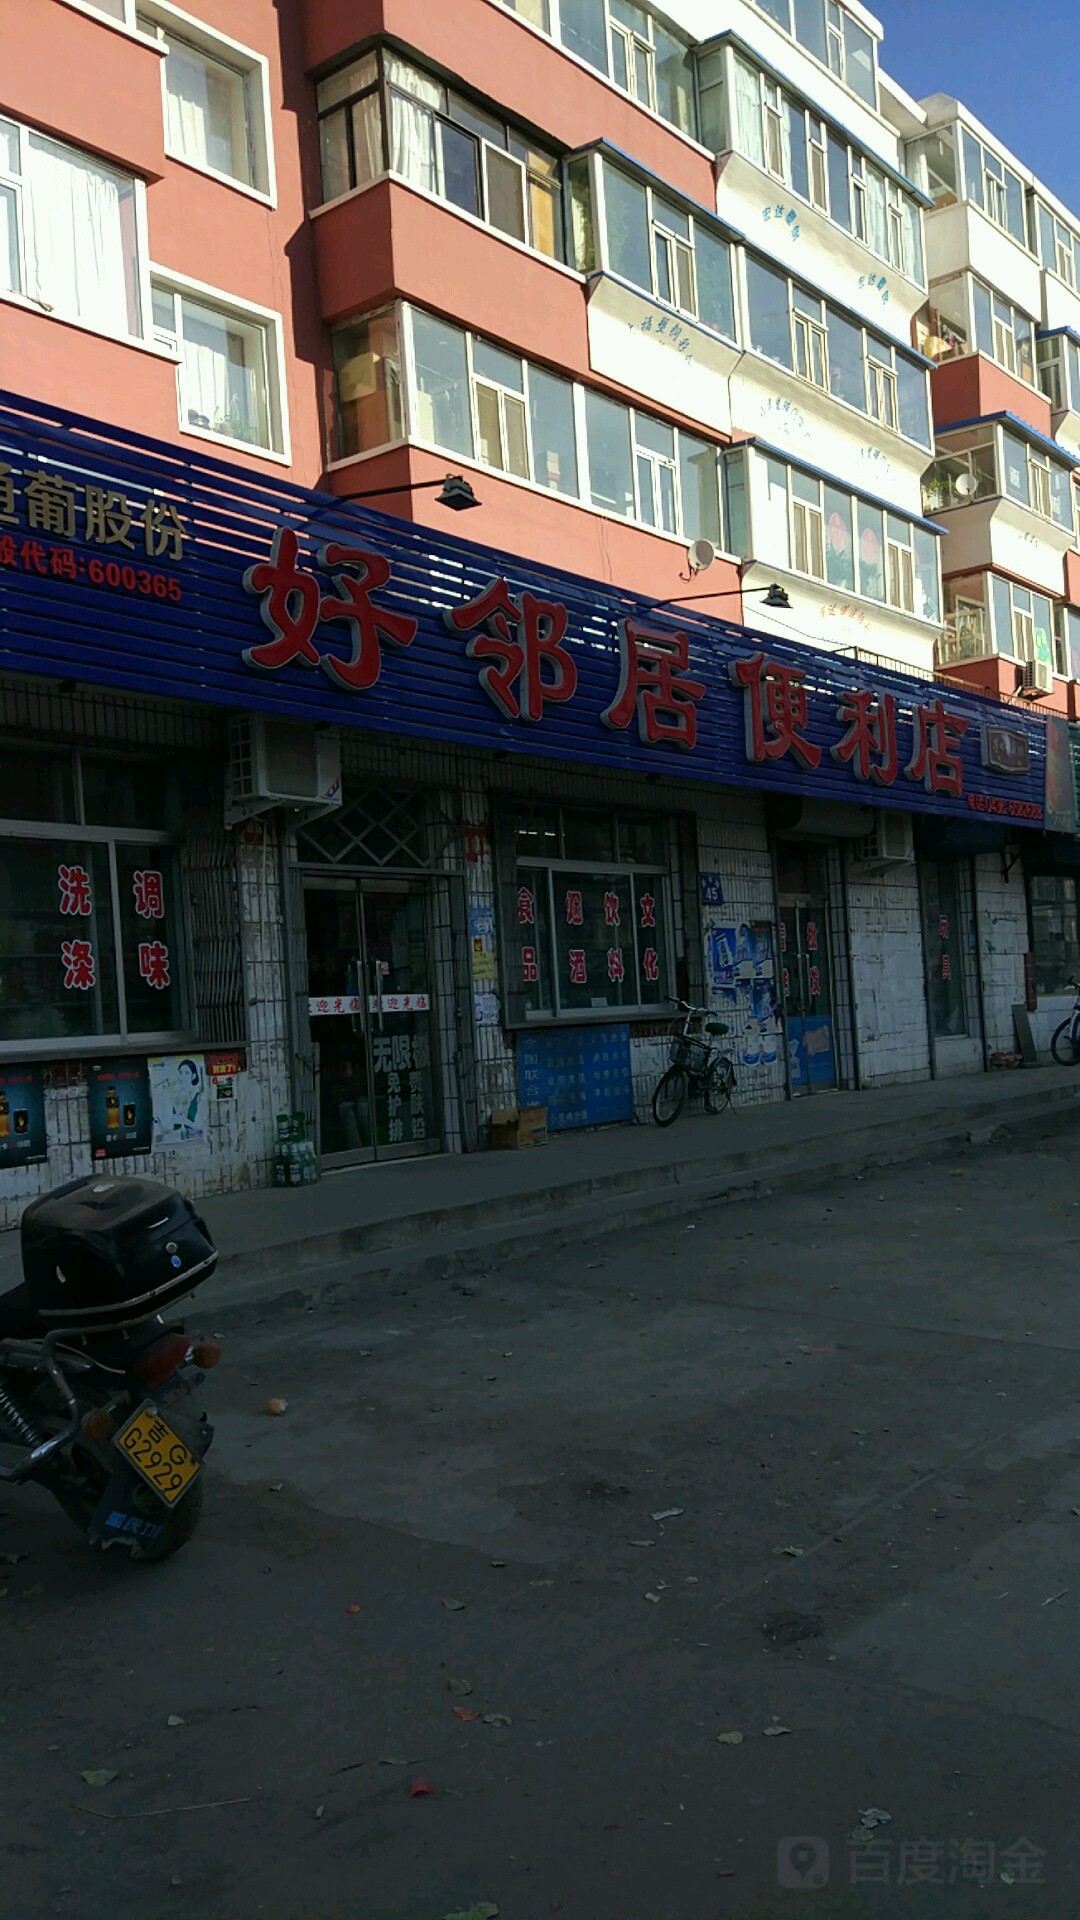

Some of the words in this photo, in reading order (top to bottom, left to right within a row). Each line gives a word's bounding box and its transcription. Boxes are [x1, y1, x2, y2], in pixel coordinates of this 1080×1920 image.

[242, 526, 967, 798] 好邻居便利店
[57, 864, 96, 990] 洗涤
[133, 870, 170, 989] 调味
[517, 886, 538, 982] 食品
[604, 891, 625, 983] 饮料
[640, 892, 659, 981] 文化
[705, 887, 718, 901] 45
[373, 1034, 431, 1074] 无限极
[124, 1427, 183, 1491] G2929
